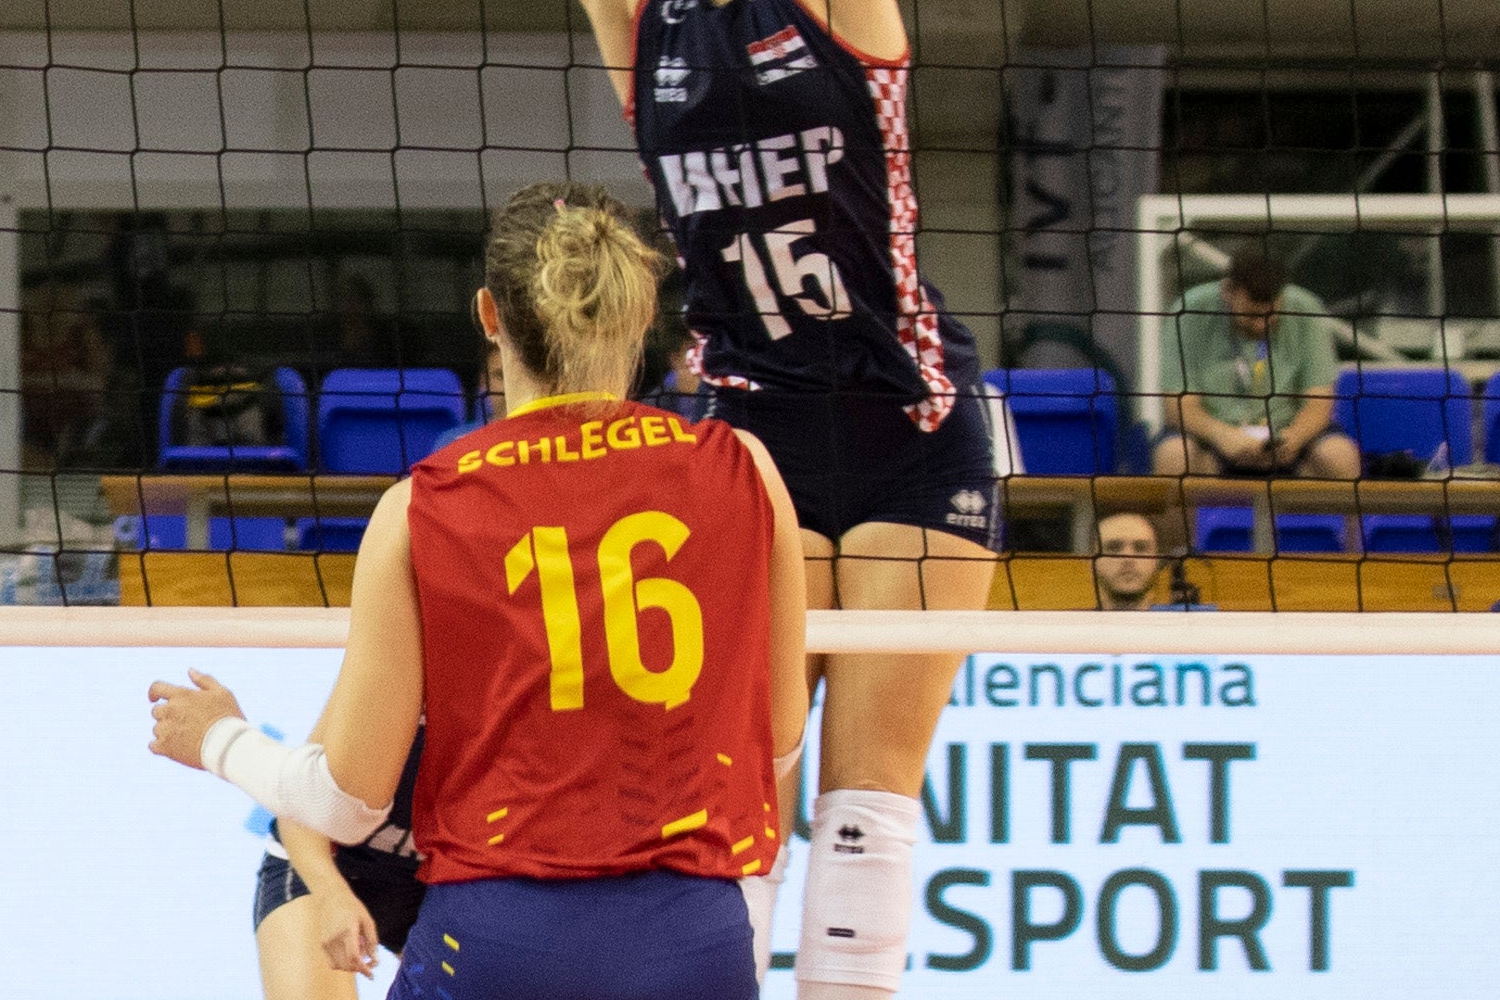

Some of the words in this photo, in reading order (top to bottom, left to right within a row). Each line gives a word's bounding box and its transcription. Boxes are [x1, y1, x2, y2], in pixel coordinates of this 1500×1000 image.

[721, 218, 853, 341] 15
[458, 415, 697, 474] SCHLEGEL
[504, 510, 704, 712] 16
[950, 653, 1257, 707] lenciana
